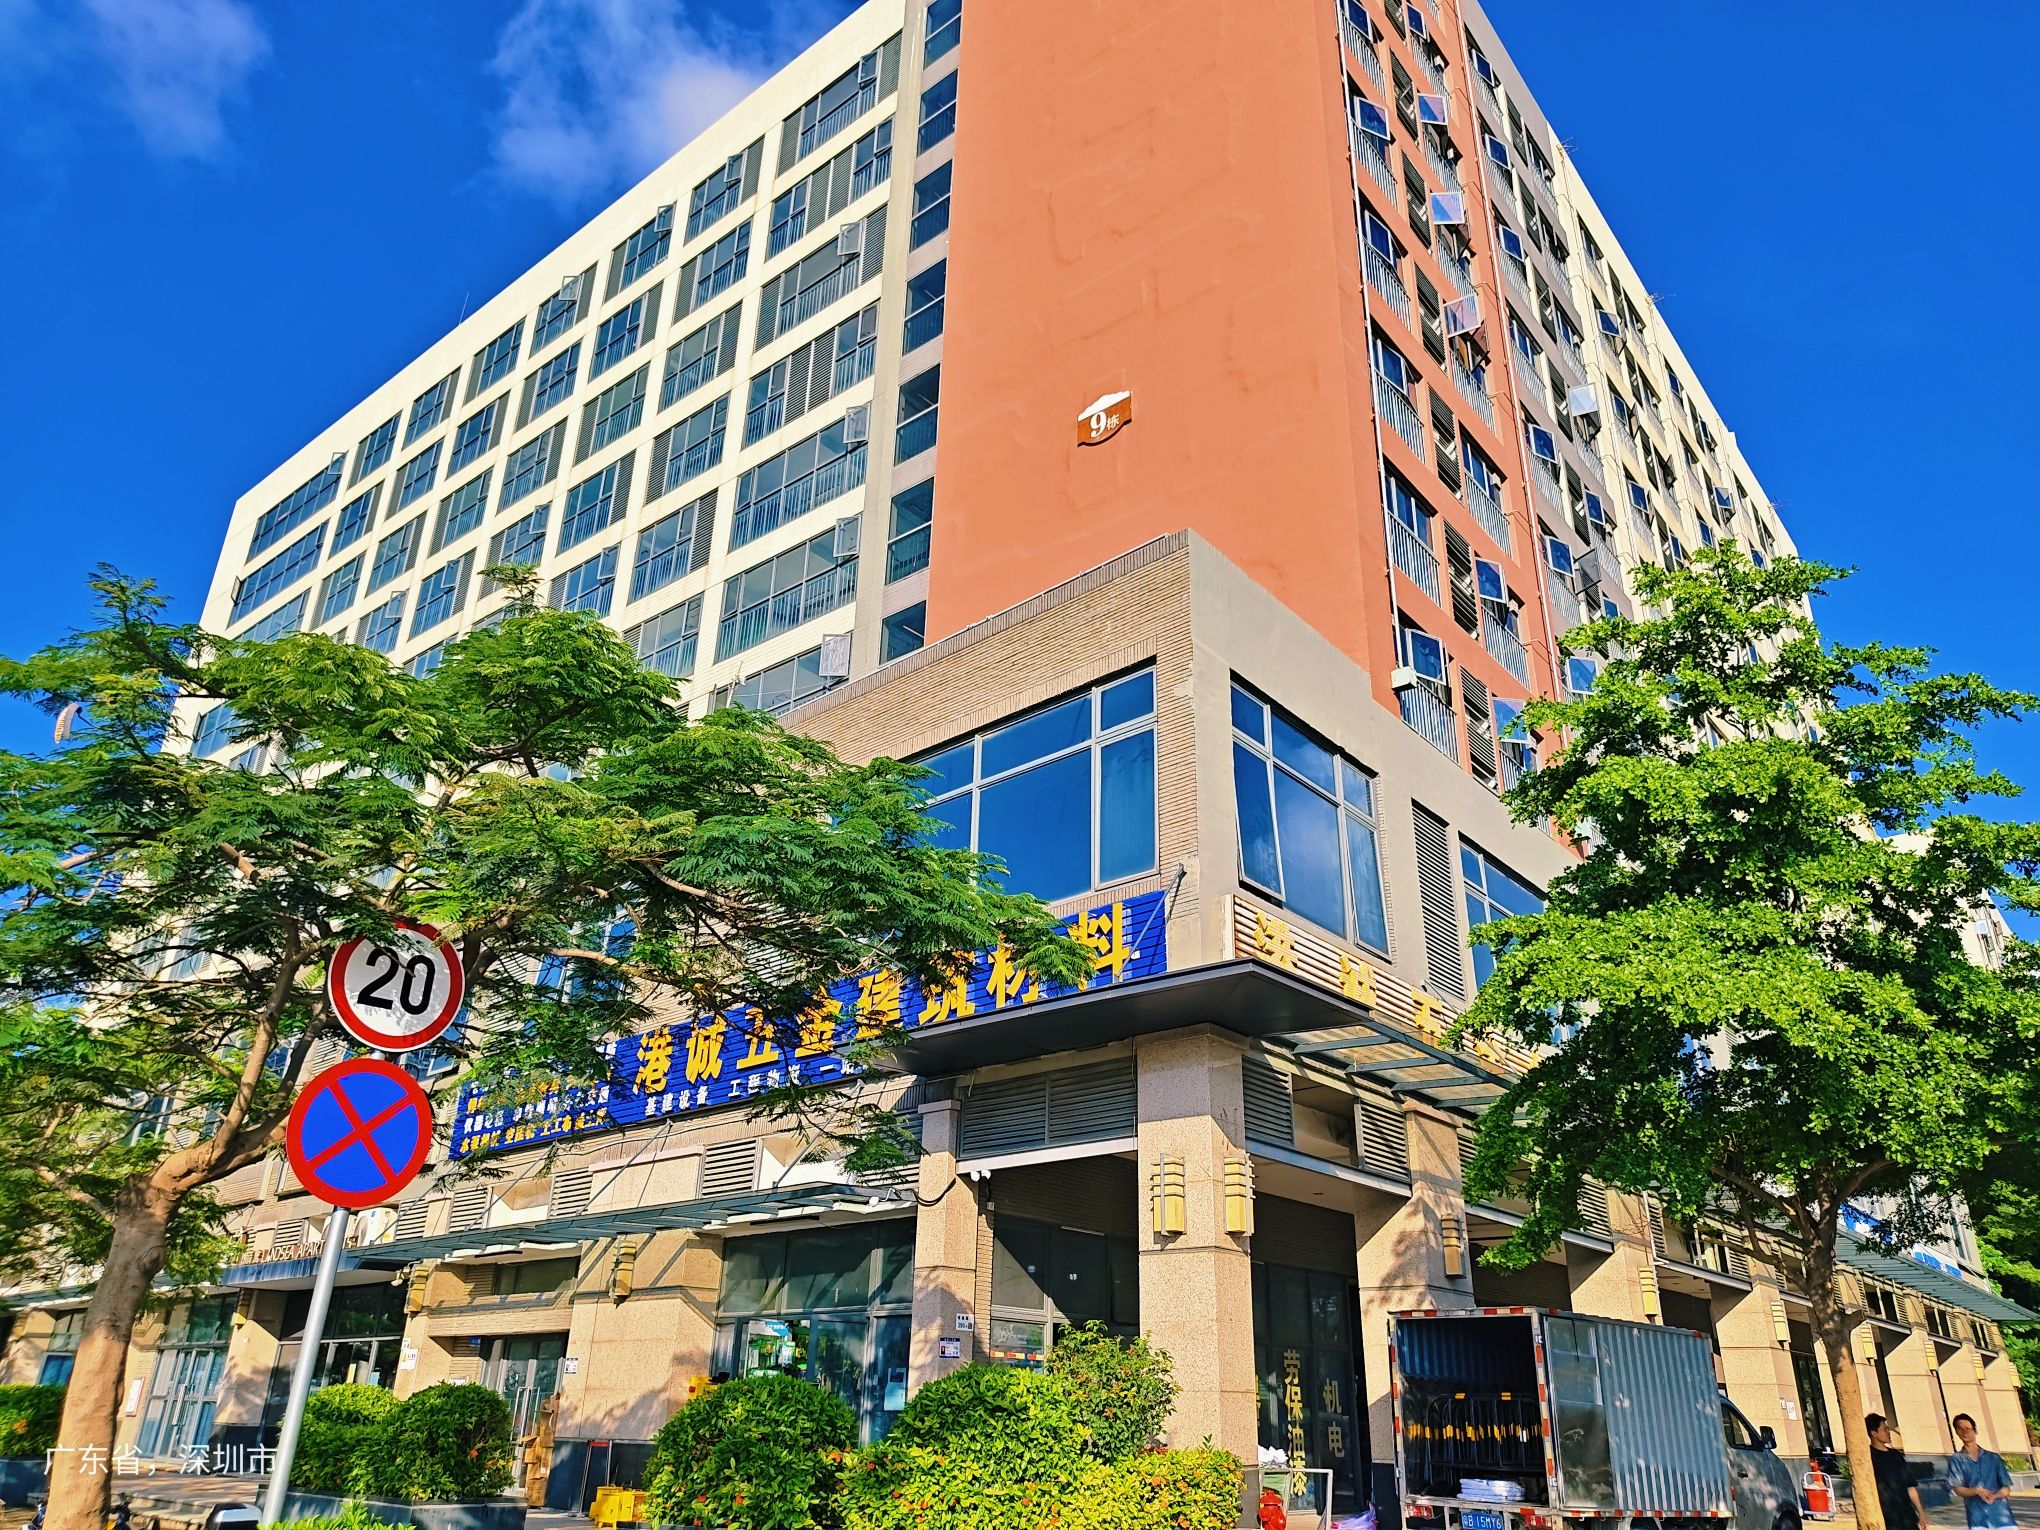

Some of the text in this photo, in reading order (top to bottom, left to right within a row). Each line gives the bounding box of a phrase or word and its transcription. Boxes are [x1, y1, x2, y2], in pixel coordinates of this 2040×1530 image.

[1090, 410, 1120, 438] 9栋
[357, 947, 436, 1016] 20
[645, 1085, 709, 1117] 基建设备
[1322, 1377, 1345, 1458] 机电
